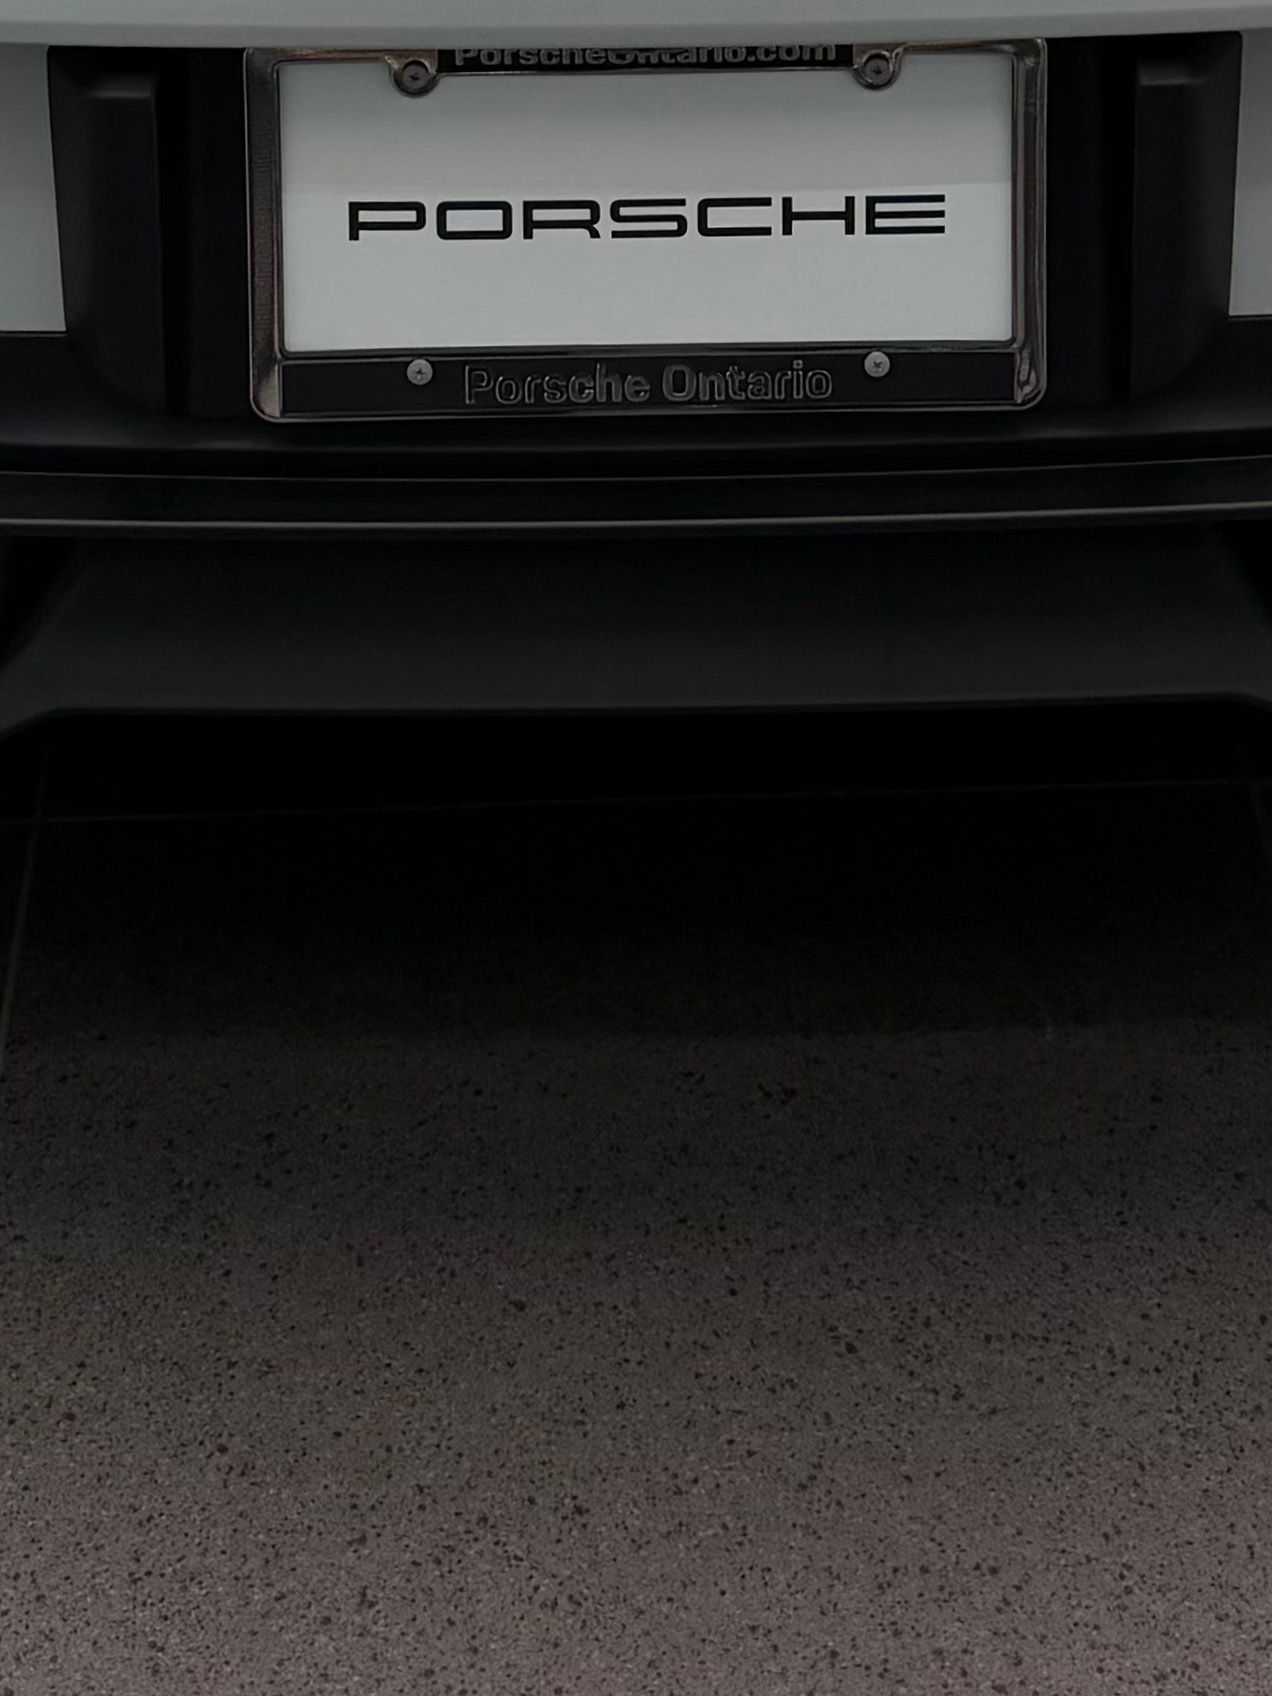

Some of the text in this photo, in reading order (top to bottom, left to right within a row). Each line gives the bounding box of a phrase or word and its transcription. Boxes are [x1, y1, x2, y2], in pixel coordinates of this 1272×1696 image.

[347, 194, 946, 241] PORSCHE
[464, 360, 833, 404] Porsche Ontario
